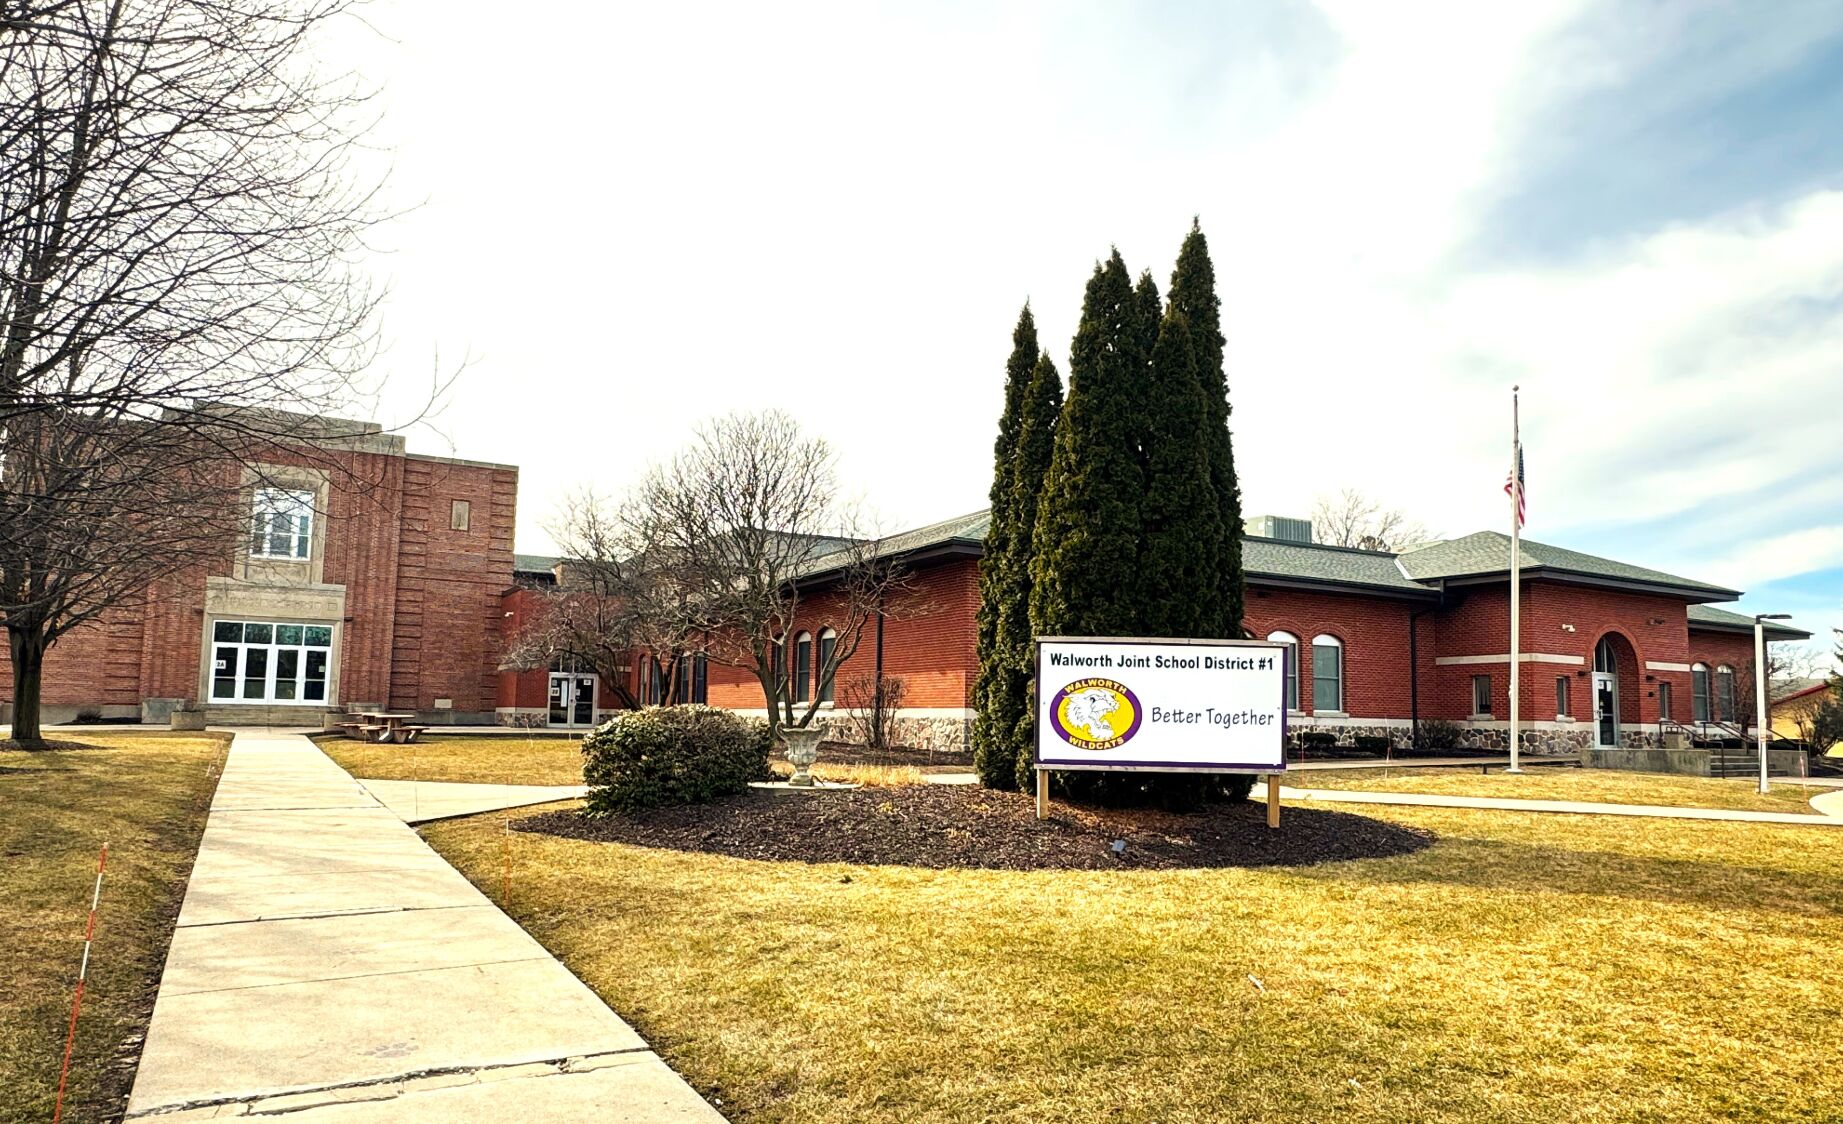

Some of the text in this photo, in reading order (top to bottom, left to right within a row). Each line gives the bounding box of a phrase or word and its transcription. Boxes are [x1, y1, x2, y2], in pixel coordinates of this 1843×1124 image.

[1050, 653, 1273, 671] Walworth Joint School District #1
[1064, 679, 1128, 694] WALWORTH
[1152, 706, 1274, 729] Better Together
[1069, 736, 1125, 750] WILDCATS
